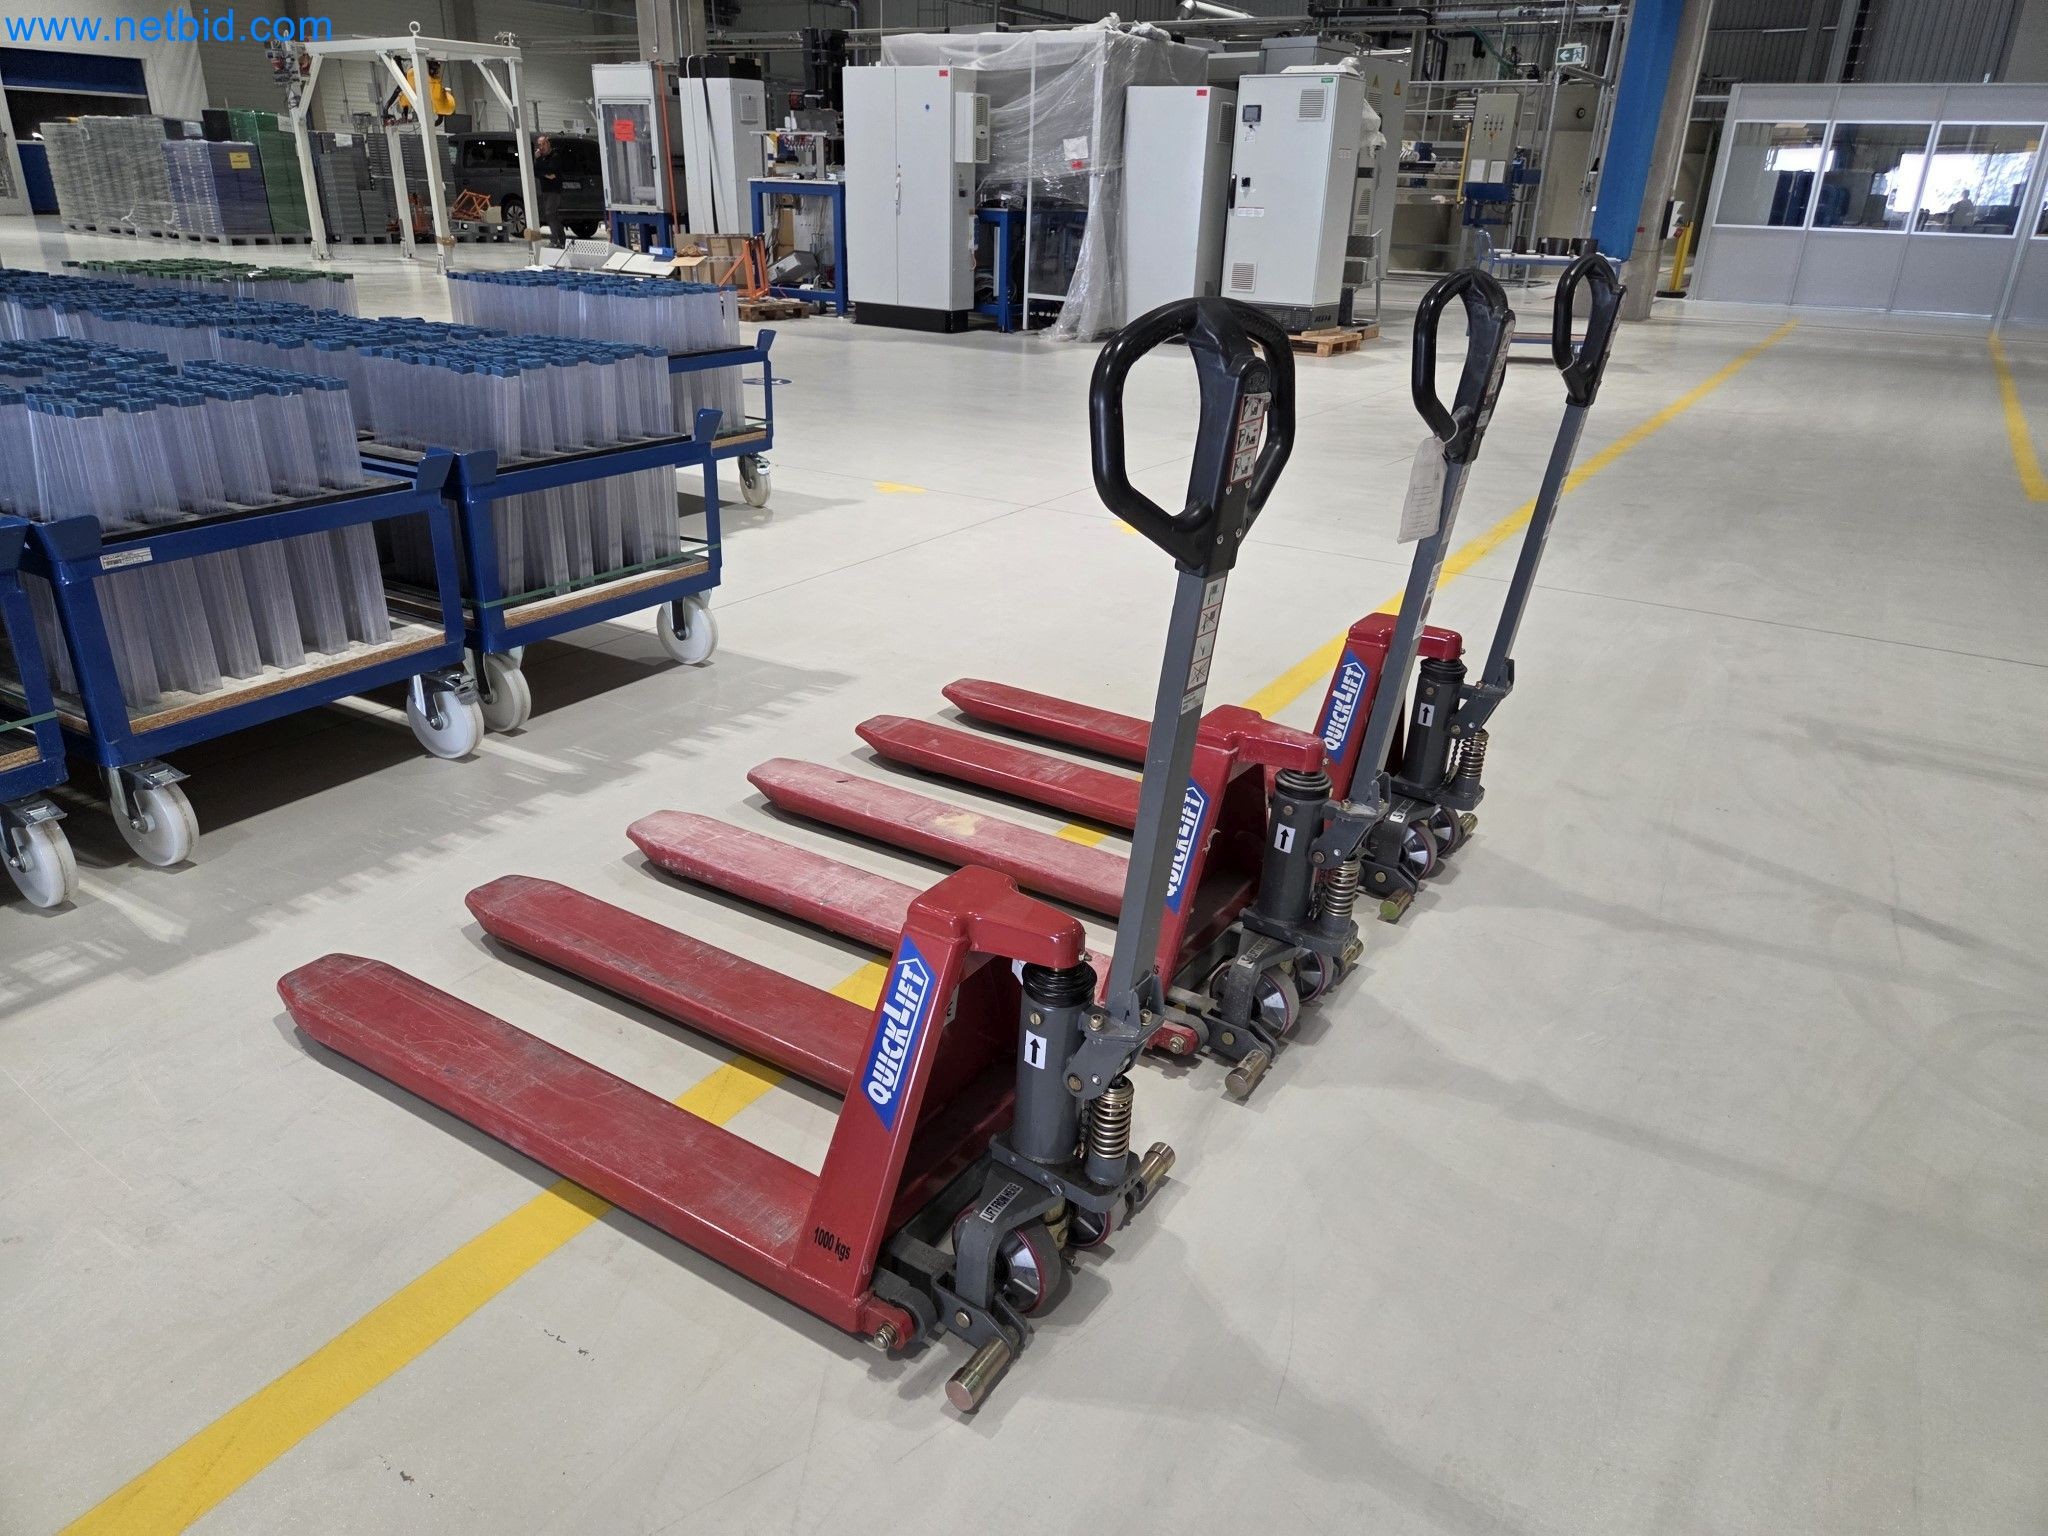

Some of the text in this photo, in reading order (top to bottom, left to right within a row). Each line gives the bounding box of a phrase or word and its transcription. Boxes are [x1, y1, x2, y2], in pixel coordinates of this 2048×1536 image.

[867, 963, 926, 1105] QUICKLIFT
[814, 1227, 851, 1261] 1000 kgs
